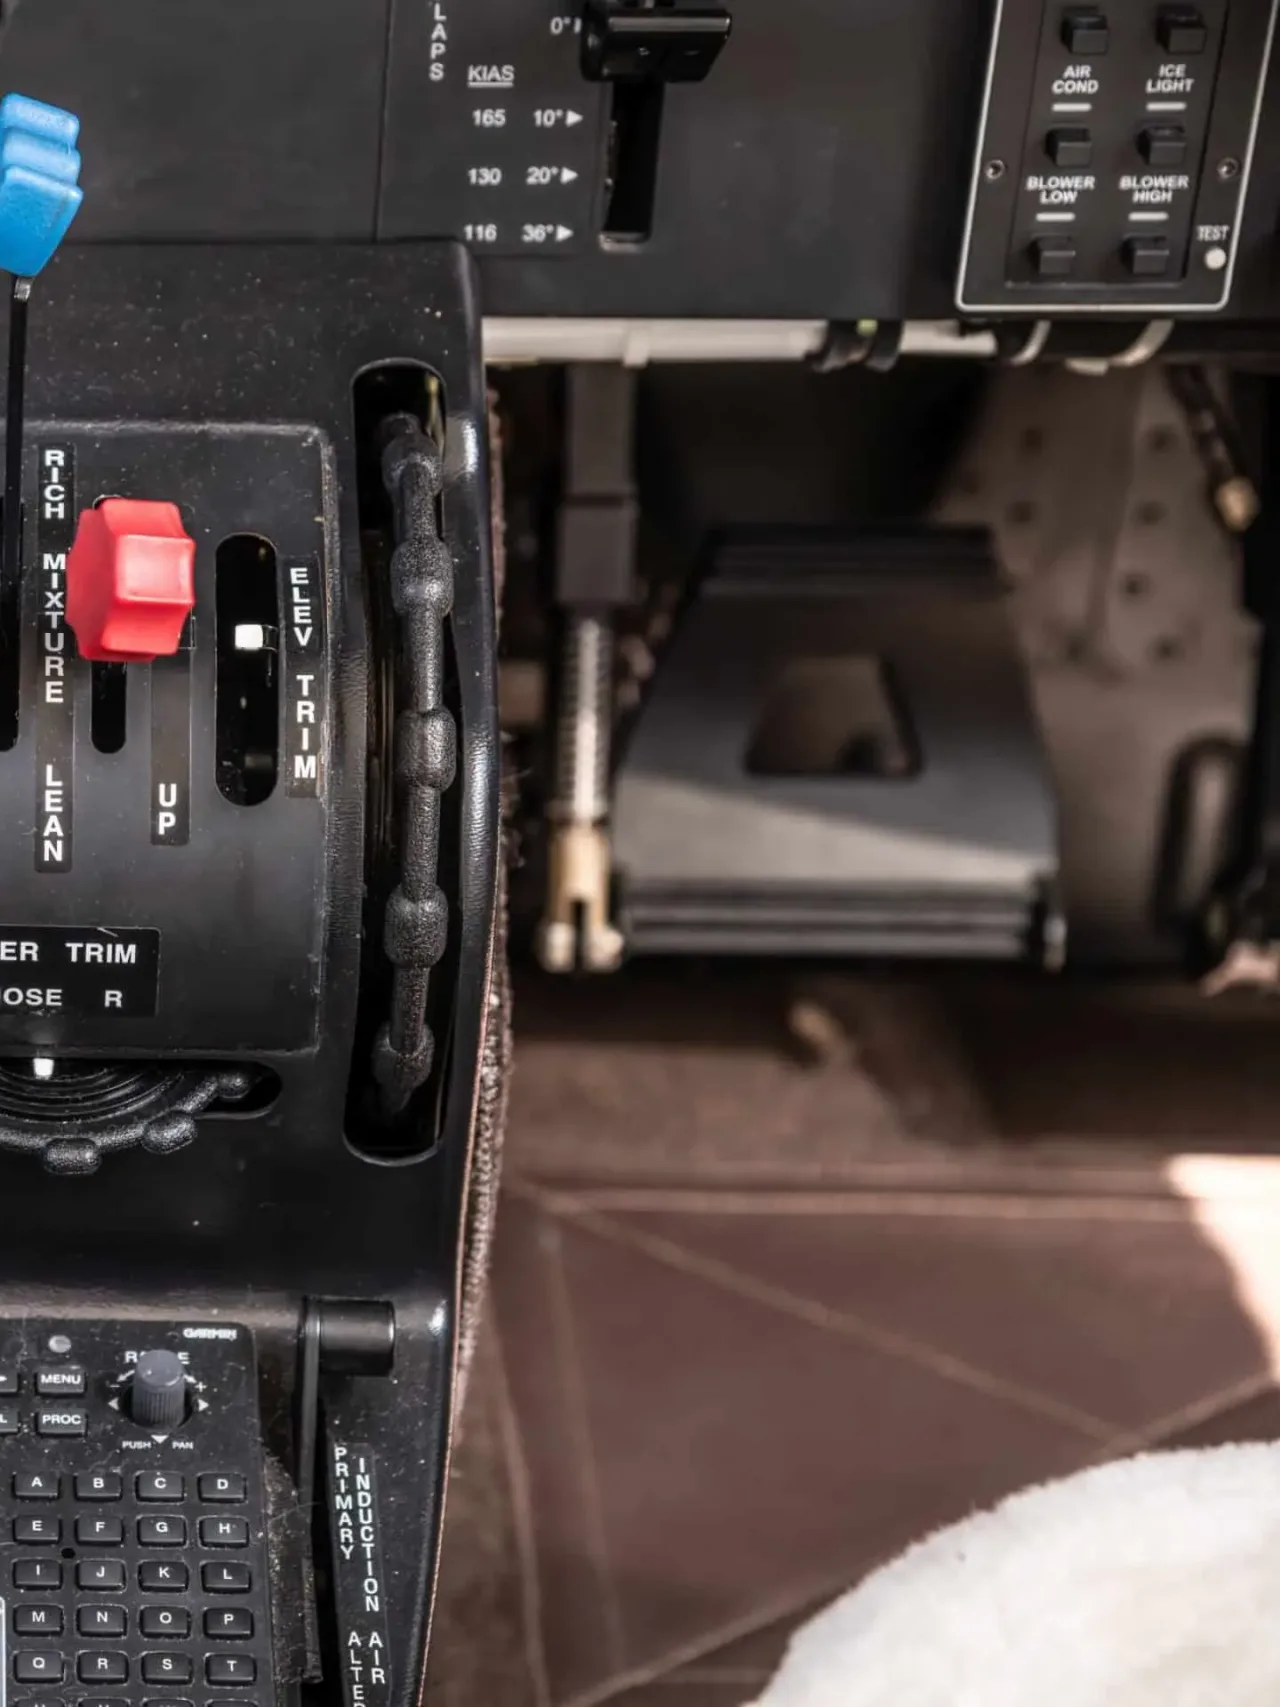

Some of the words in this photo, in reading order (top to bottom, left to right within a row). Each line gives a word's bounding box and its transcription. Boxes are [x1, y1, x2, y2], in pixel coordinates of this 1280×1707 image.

[428, 0, 449, 82] LAPS
[466, 63, 516, 90] KIAS
[1064, 66, 1090, 78] AIR
[1159, 64, 1187, 78] ICE
[1053, 80, 1098, 93] COND
[1147, 79, 1193, 92] LIGHT
[474, 109, 505, 126] 165
[534, 110, 562, 126] 10°
[469, 168, 501, 185] 130
[527, 167, 558, 184] 20°
[1027, 176, 1095, 190] BLOWER
[1120, 176, 1188, 189] BLOWER
[1041, 190, 1077, 203] LOW
[1133, 190, 1172, 202] HIGH
[465, 224, 496, 241] 116
[523, 225, 553, 241] 36°
[1198, 226, 1228, 240] TEST
[44, 450, 64, 518] RICH
[290, 568, 312, 646] ELEV
[43, 554, 66, 703] MIXTURE
[295, 675, 316, 778] TRIM
[44, 764, 63, 861] LEAN
[159, 783, 176, 835] UP
[66, 943, 136, 963] TRIM
[105, 990, 122, 1007] R
[183, 1328, 236, 1340] GARMIN
[41, 1374, 81, 1384] MENU
[43, 1415, 81, 1424] PROC
[32, 1477, 42, 1487] A
[94, 1478, 104, 1488] B
[155, 1478, 166, 1488] C
[217, 1479, 228, 1489] D
[334, 1445, 354, 1562] PRIMARY
[33, 1521, 42, 1531] E
[96, 1522, 104, 1532] F
[156, 1522, 168, 1532] G
[219, 1523, 230, 1533] H
[36, 1565, 40, 1575] I
[96, 1567, 104, 1577] J
[159, 1567, 169, 1578] K
[223, 1569, 232, 1579] L
[355, 1456, 380, 1613] INDUCTION
[369, 1632, 385, 1684] AIR
[32, 1611, 45, 1622] M
[97, 1612, 107, 1622] N
[160, 1613, 172, 1624] O
[224, 1614, 233, 1624] P
[33, 1657, 45, 1668] Q
[98, 1658, 108, 1669] R
[163, 1659, 172, 1670] S
[227, 1661, 236, 1671] T
